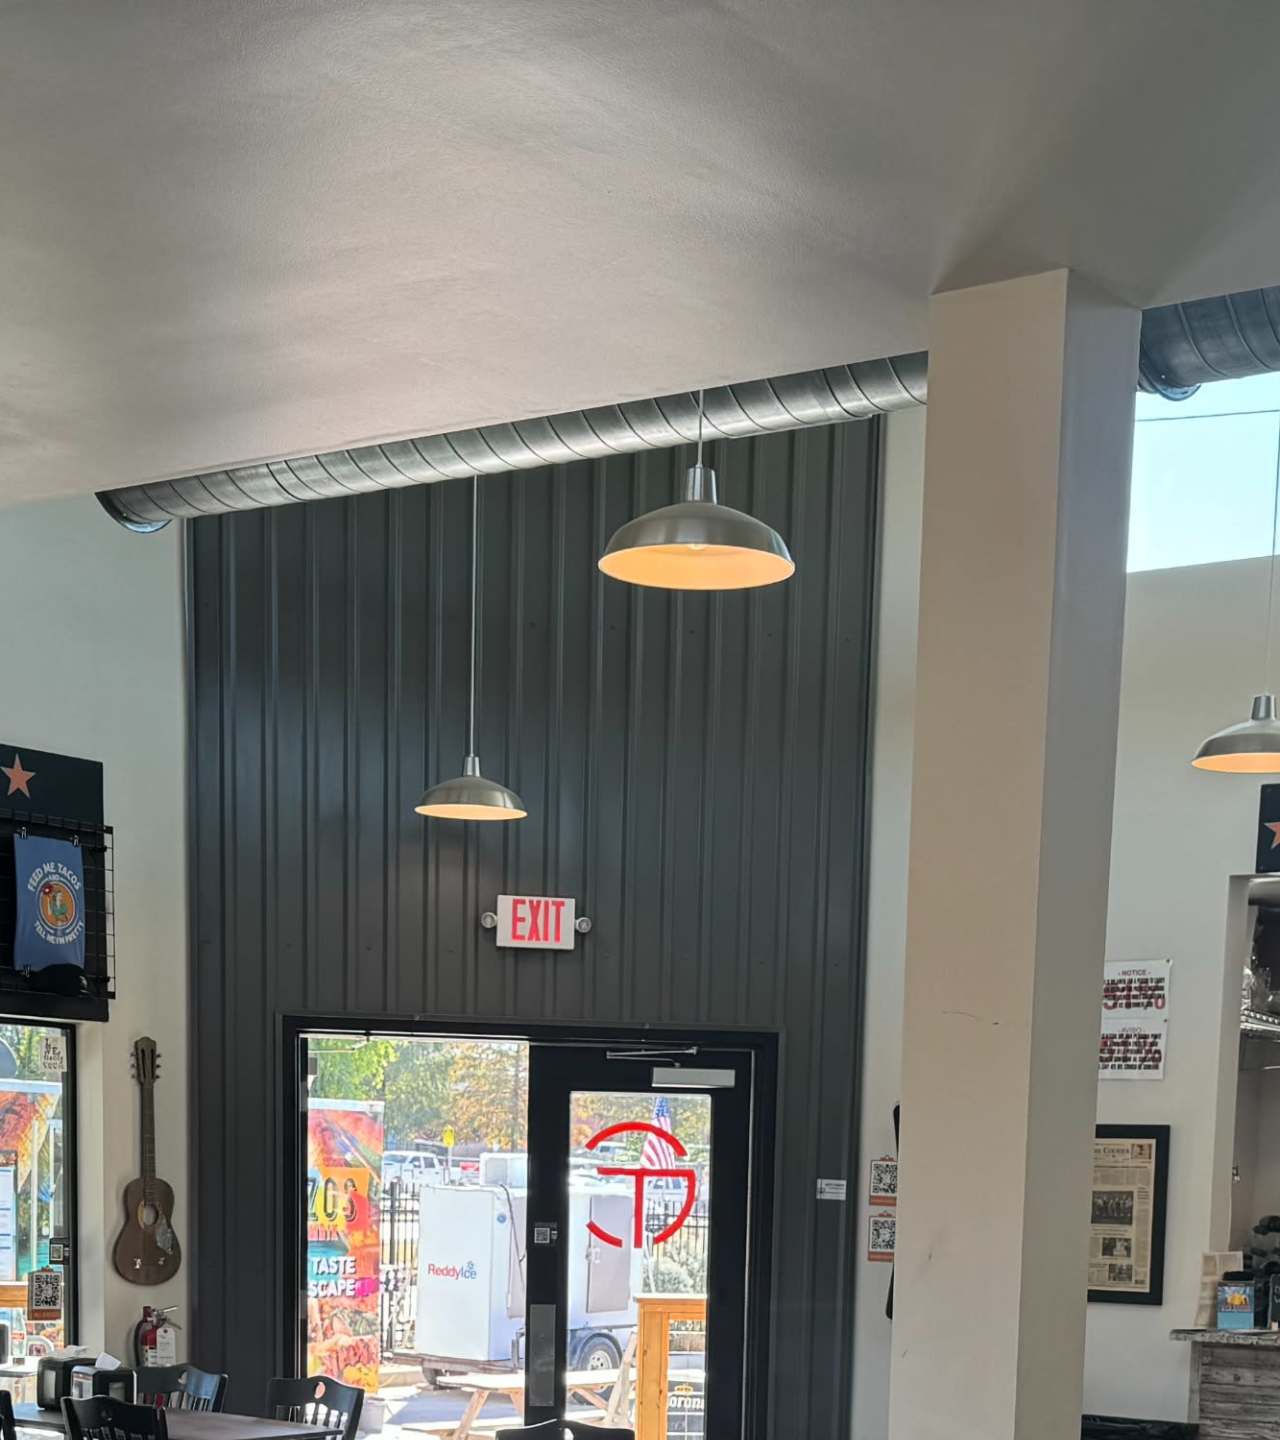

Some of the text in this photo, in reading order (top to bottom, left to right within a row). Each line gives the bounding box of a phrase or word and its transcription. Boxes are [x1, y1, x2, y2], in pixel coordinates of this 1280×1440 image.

[27, 862, 82, 892] FEED ME TACOS
[512, 898, 565, 943] EXIT
[312, 1256, 357, 1276] TASTE
[670, 1396, 704, 1410] oron
